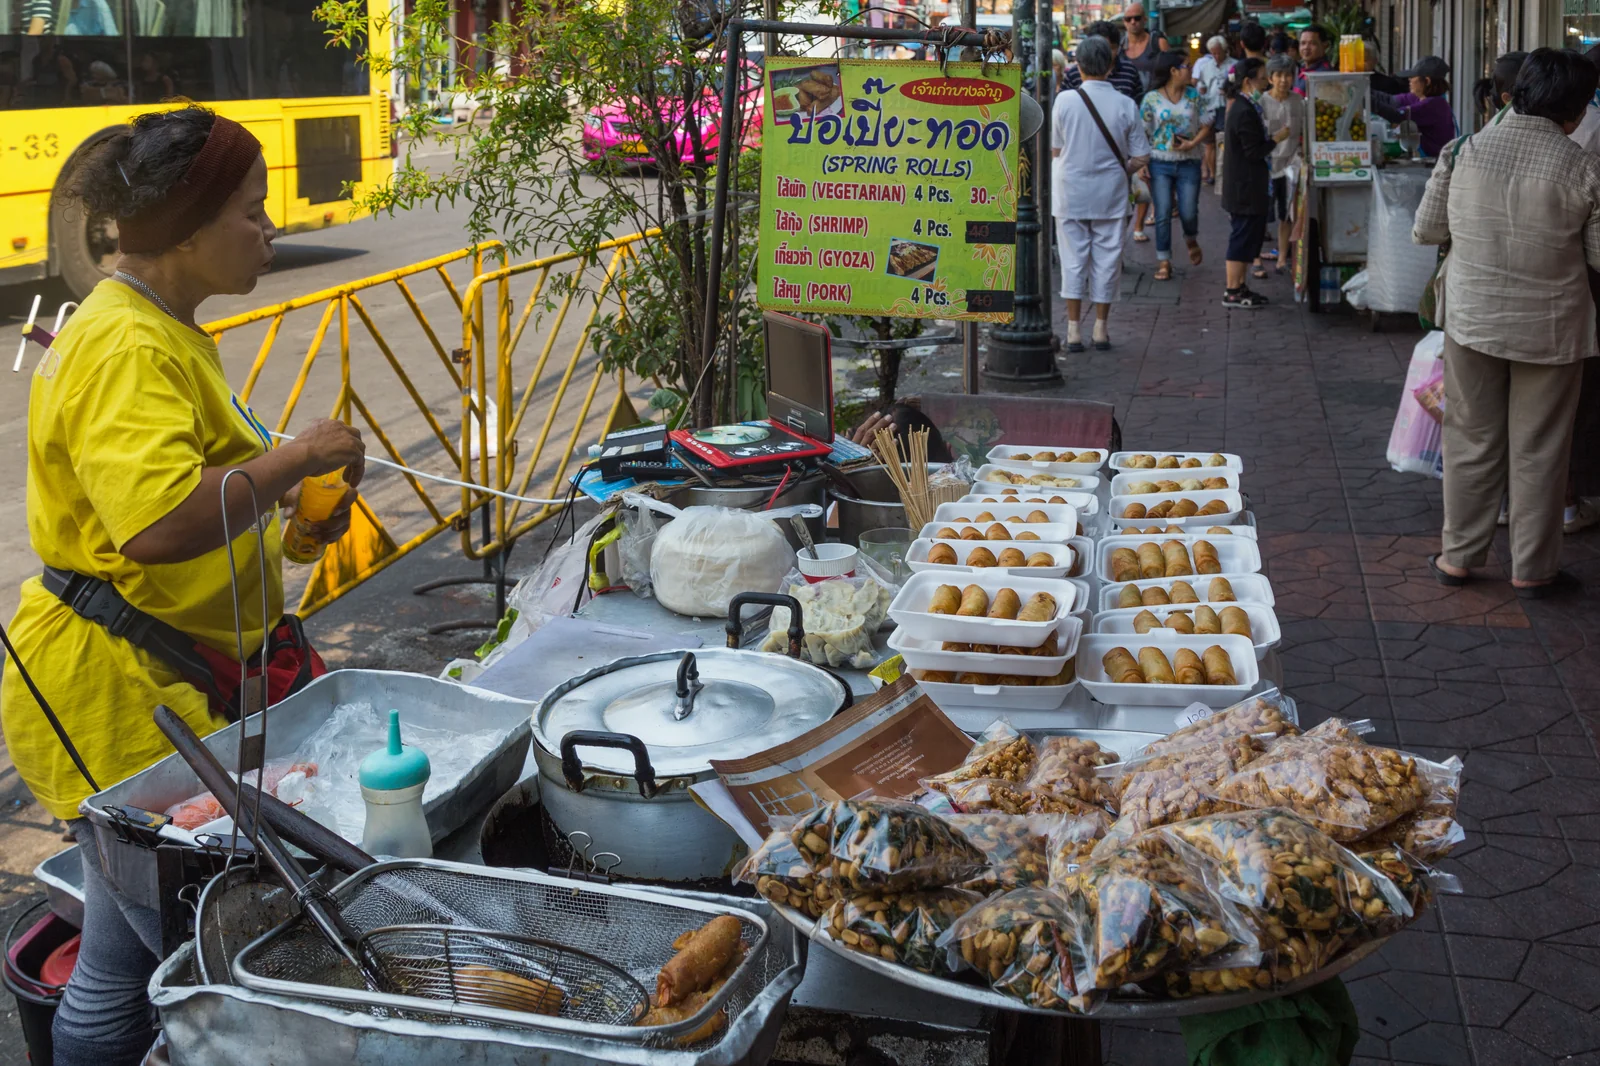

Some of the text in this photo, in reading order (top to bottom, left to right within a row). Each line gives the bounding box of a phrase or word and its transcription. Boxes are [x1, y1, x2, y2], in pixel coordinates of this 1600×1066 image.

[787, 77, 1011, 152] ปอเปี๊ยะทอด
[0, 133, 58, 160] -33
[822, 155, 973, 180] (SPRING ROLLS)
[812, 181, 906, 205] (VEGETARIAN)
[914, 185, 923, 202] 4
[928, 185, 953, 203] Pcs.
[808, 214, 868, 238] (SHRIMP)
[913, 219, 922, 236] 4
[927, 219, 952, 237] Pcs.
[818, 249, 875, 272] (GYOZA)
[807, 282, 852, 304] (PORK)
[911, 287, 919, 305] 4
[925, 288, 950, 306] Pcs.
